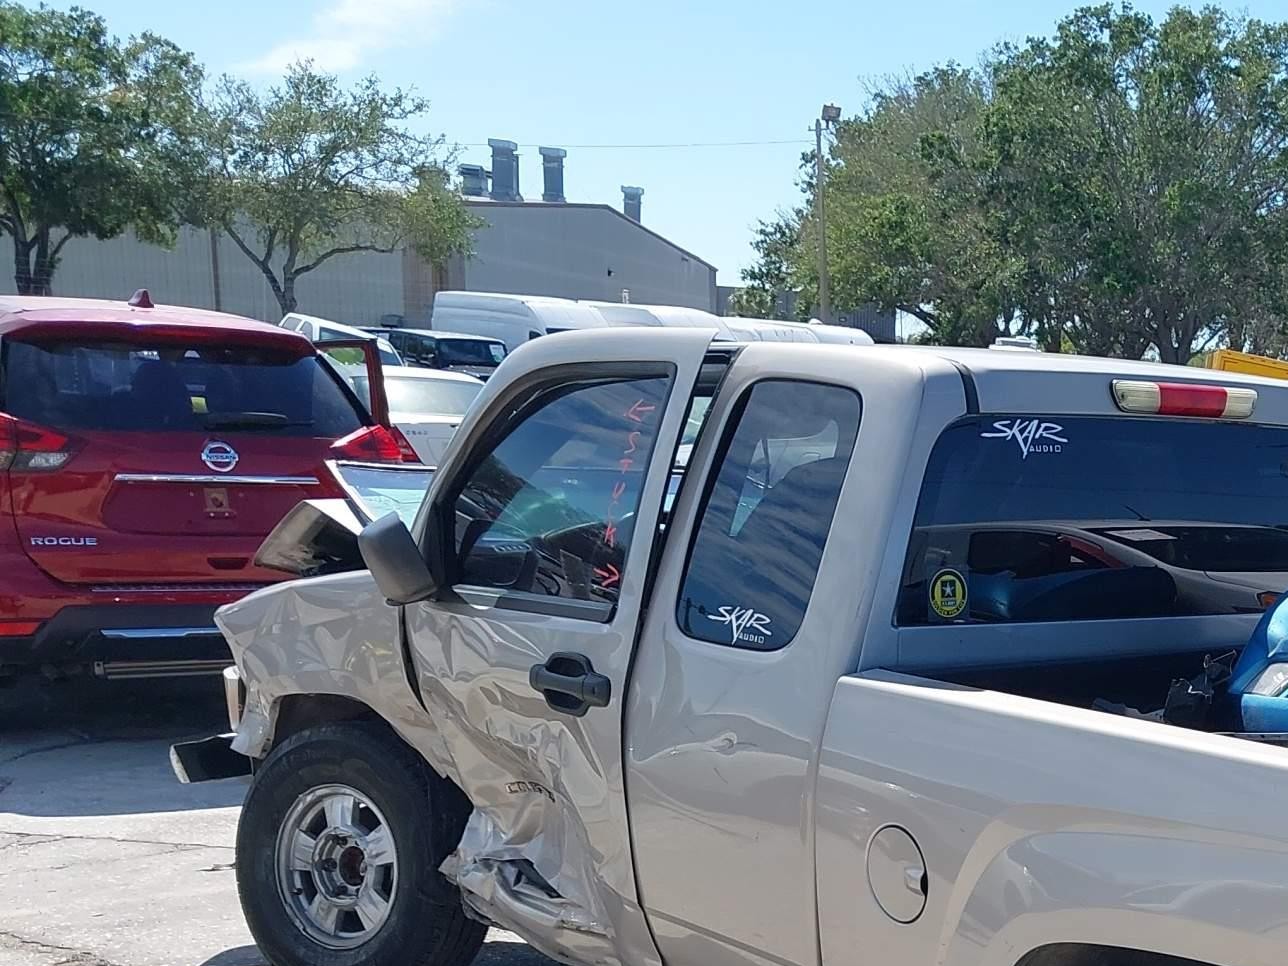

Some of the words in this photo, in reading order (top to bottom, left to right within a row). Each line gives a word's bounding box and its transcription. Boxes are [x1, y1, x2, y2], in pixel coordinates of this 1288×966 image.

[980, 419, 1068, 459] SKAR
[1029, 444, 1062, 453] AUDIO
[31, 537, 97, 546] ROGUE
[707, 606, 772, 645] SKAR
[738, 632, 765, 644] AUDIO
